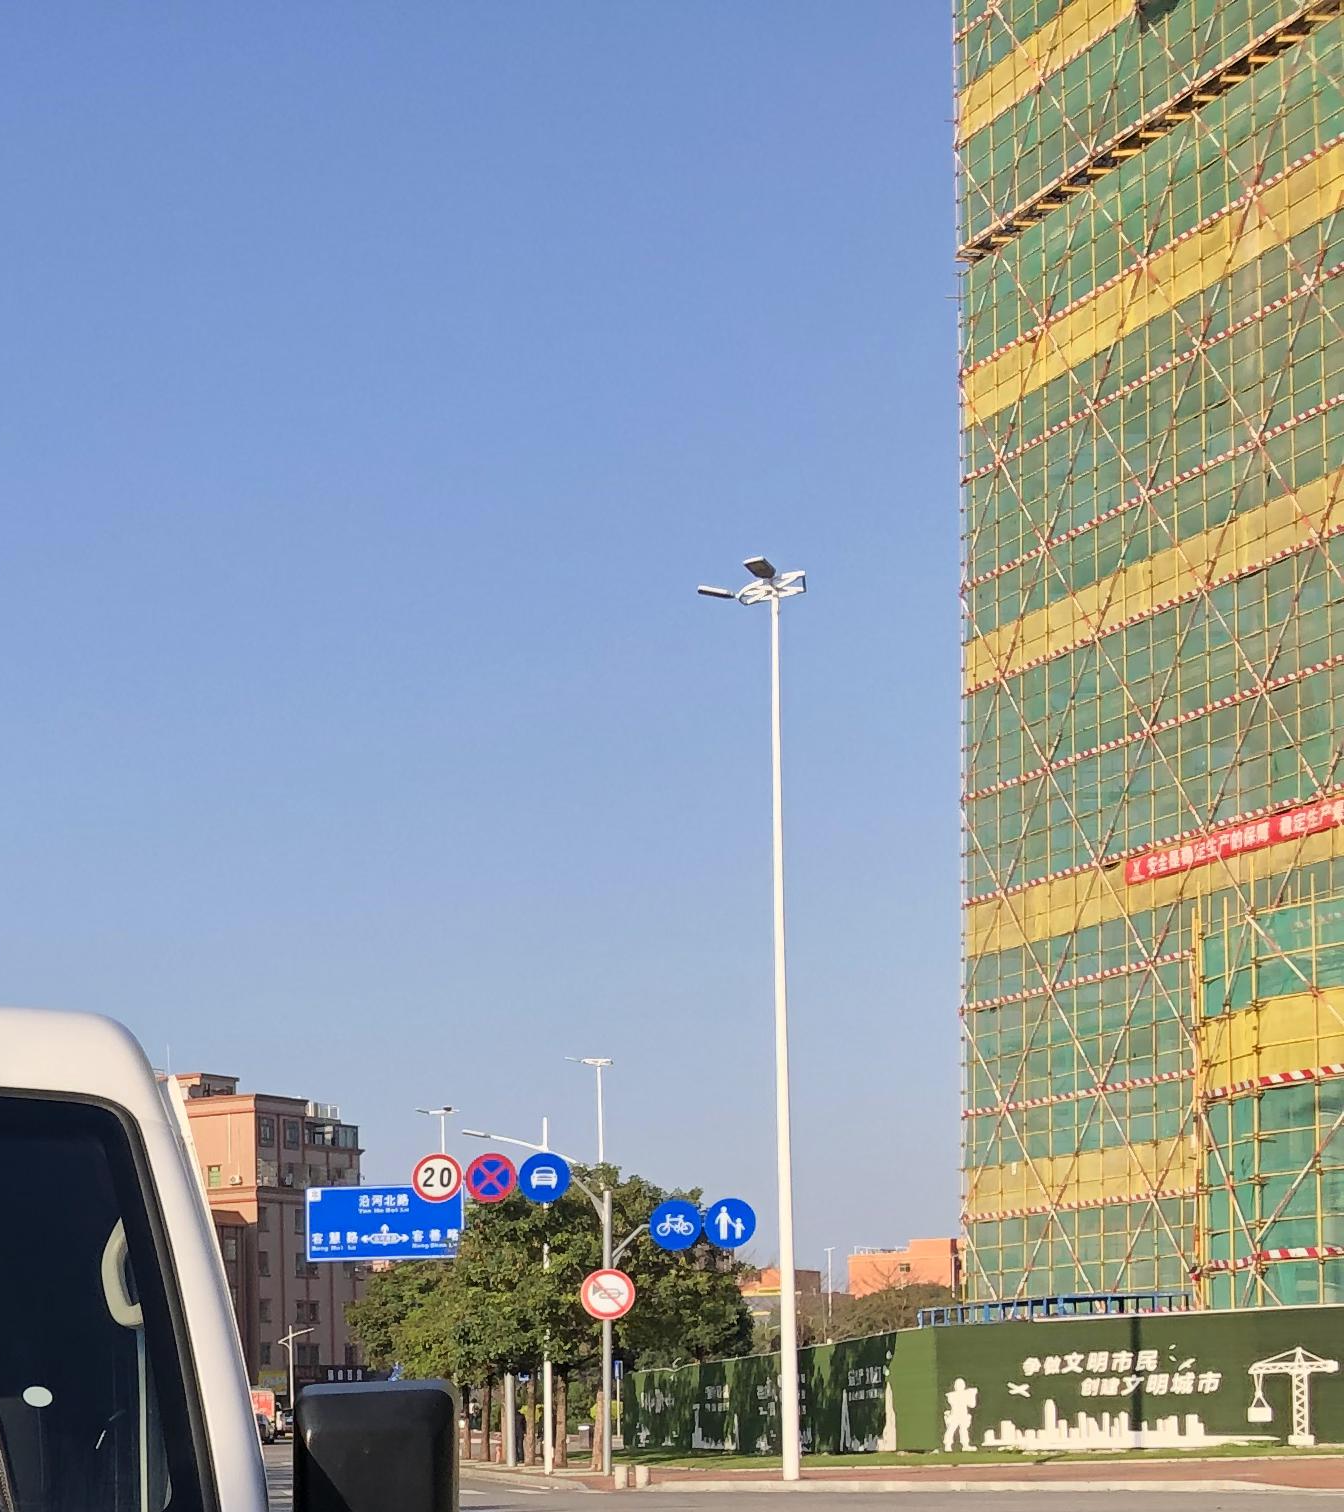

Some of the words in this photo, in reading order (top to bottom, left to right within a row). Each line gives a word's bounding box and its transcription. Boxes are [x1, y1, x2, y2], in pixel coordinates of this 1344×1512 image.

[422, 1167, 452, 1188] 20
[358, 1193, 410, 1208] 沿河北路
[1021, 1349, 1159, 1377] 争做文明市民
[1080, 1370, 1223, 1397] 创建文明城市
